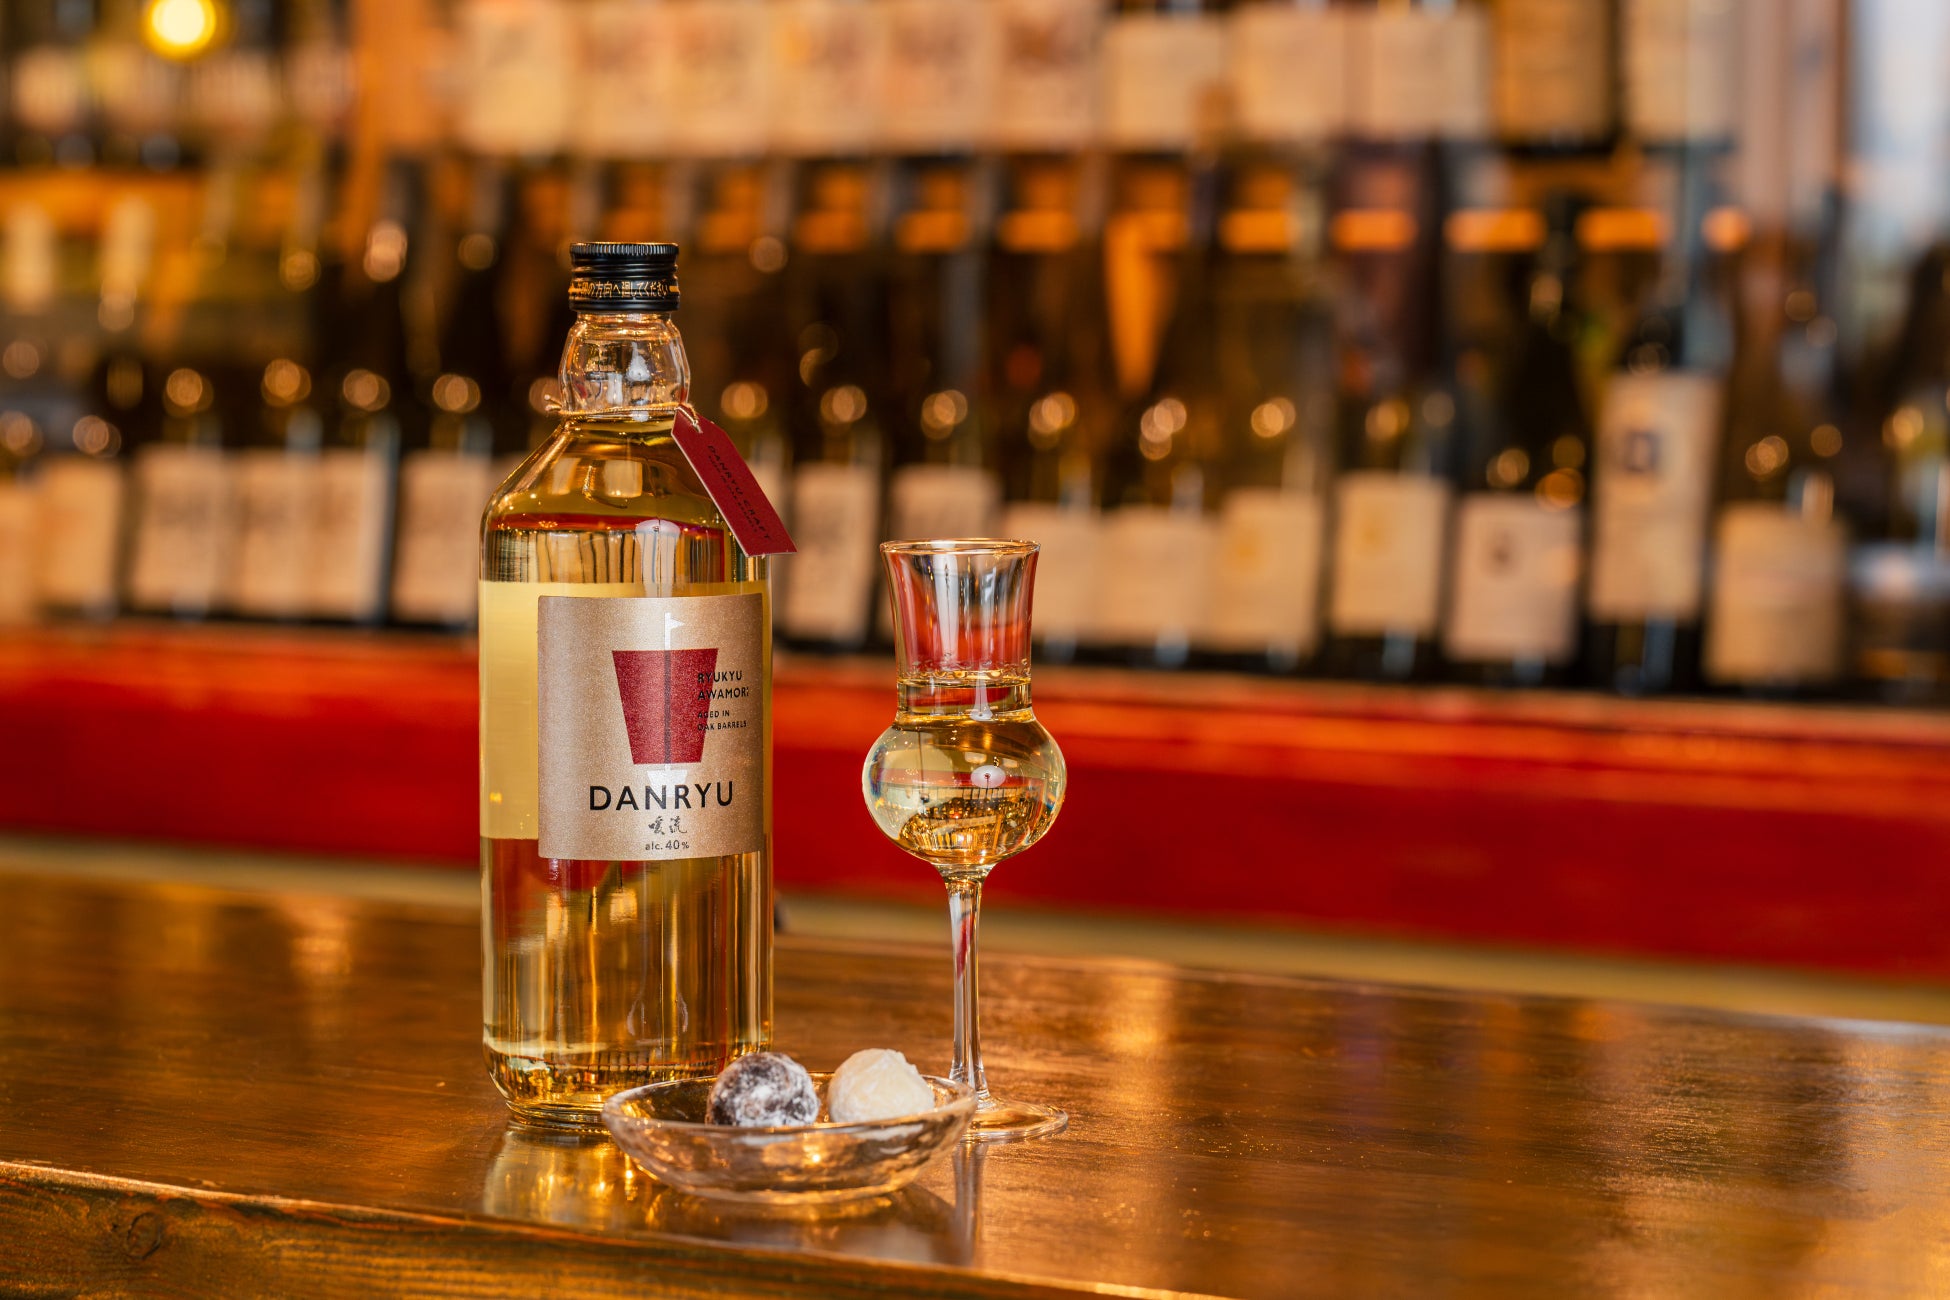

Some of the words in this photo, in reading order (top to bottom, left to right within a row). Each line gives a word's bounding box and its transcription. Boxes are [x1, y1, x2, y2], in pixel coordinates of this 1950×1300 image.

[698, 670, 742, 683] RYUKYU
[698, 687, 749, 700] AWAMORI
[698, 723, 715, 731] OAK
[718, 721, 747, 729] BARRELS
[589, 781, 733, 810] DANRYU
